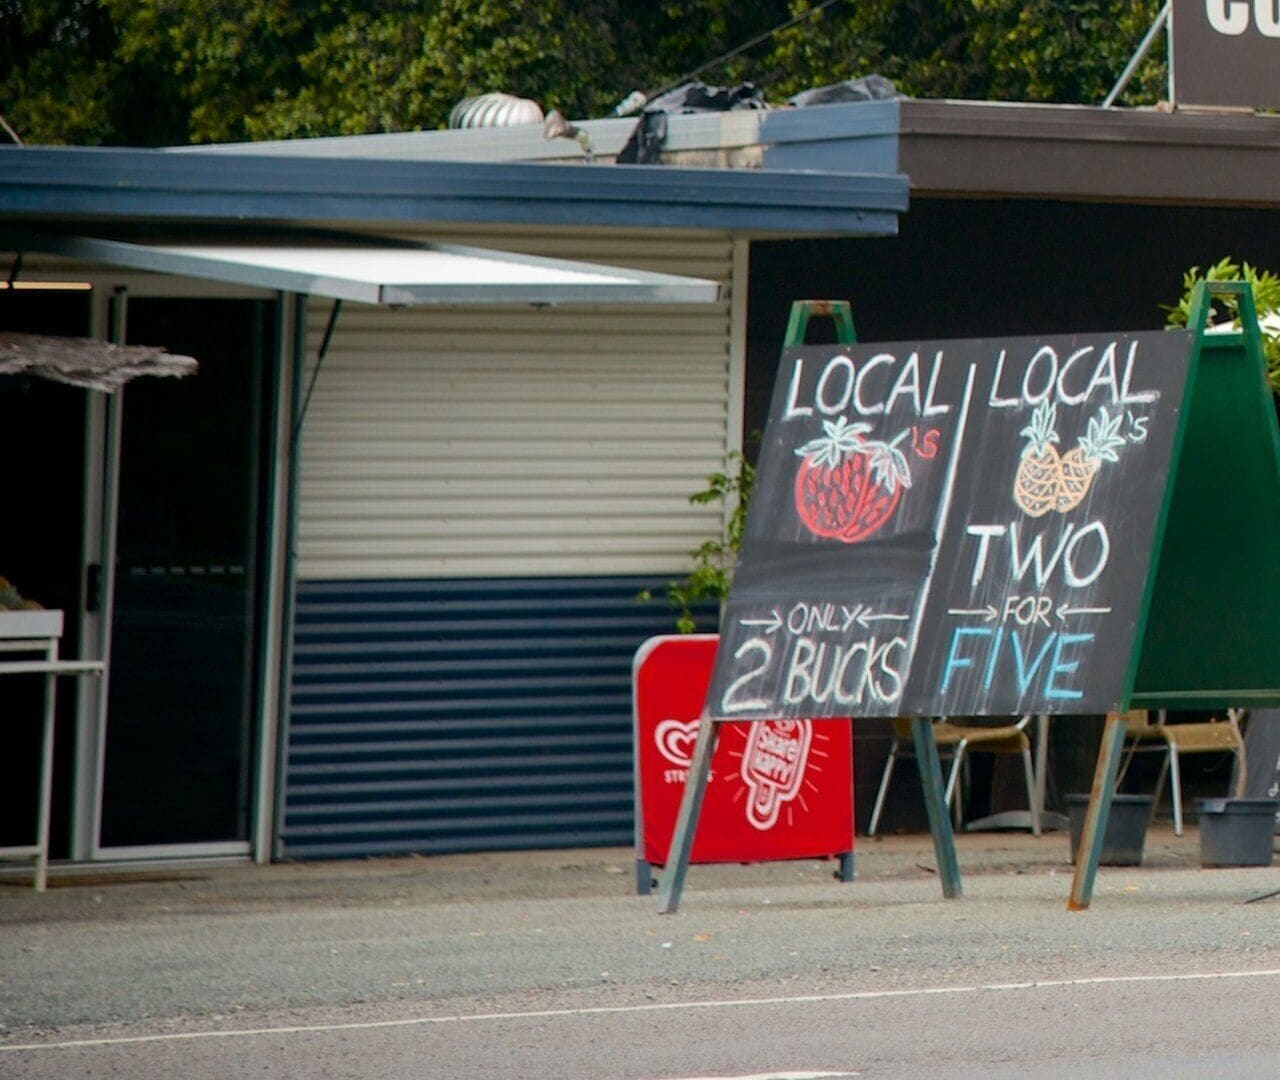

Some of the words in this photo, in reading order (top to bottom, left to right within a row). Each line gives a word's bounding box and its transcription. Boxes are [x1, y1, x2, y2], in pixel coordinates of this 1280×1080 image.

[785, 350, 950, 417] LOCAL
[988, 340, 1160, 407] LOCAL
[966, 520, 1111, 591] TWO
[787, 602, 863, 634] ONLY
[1002, 595, 1053, 627] FOR
[722, 638, 773, 713] 2
[784, 636, 908, 705] BUCKS
[940, 627, 1096, 700] FIVE
